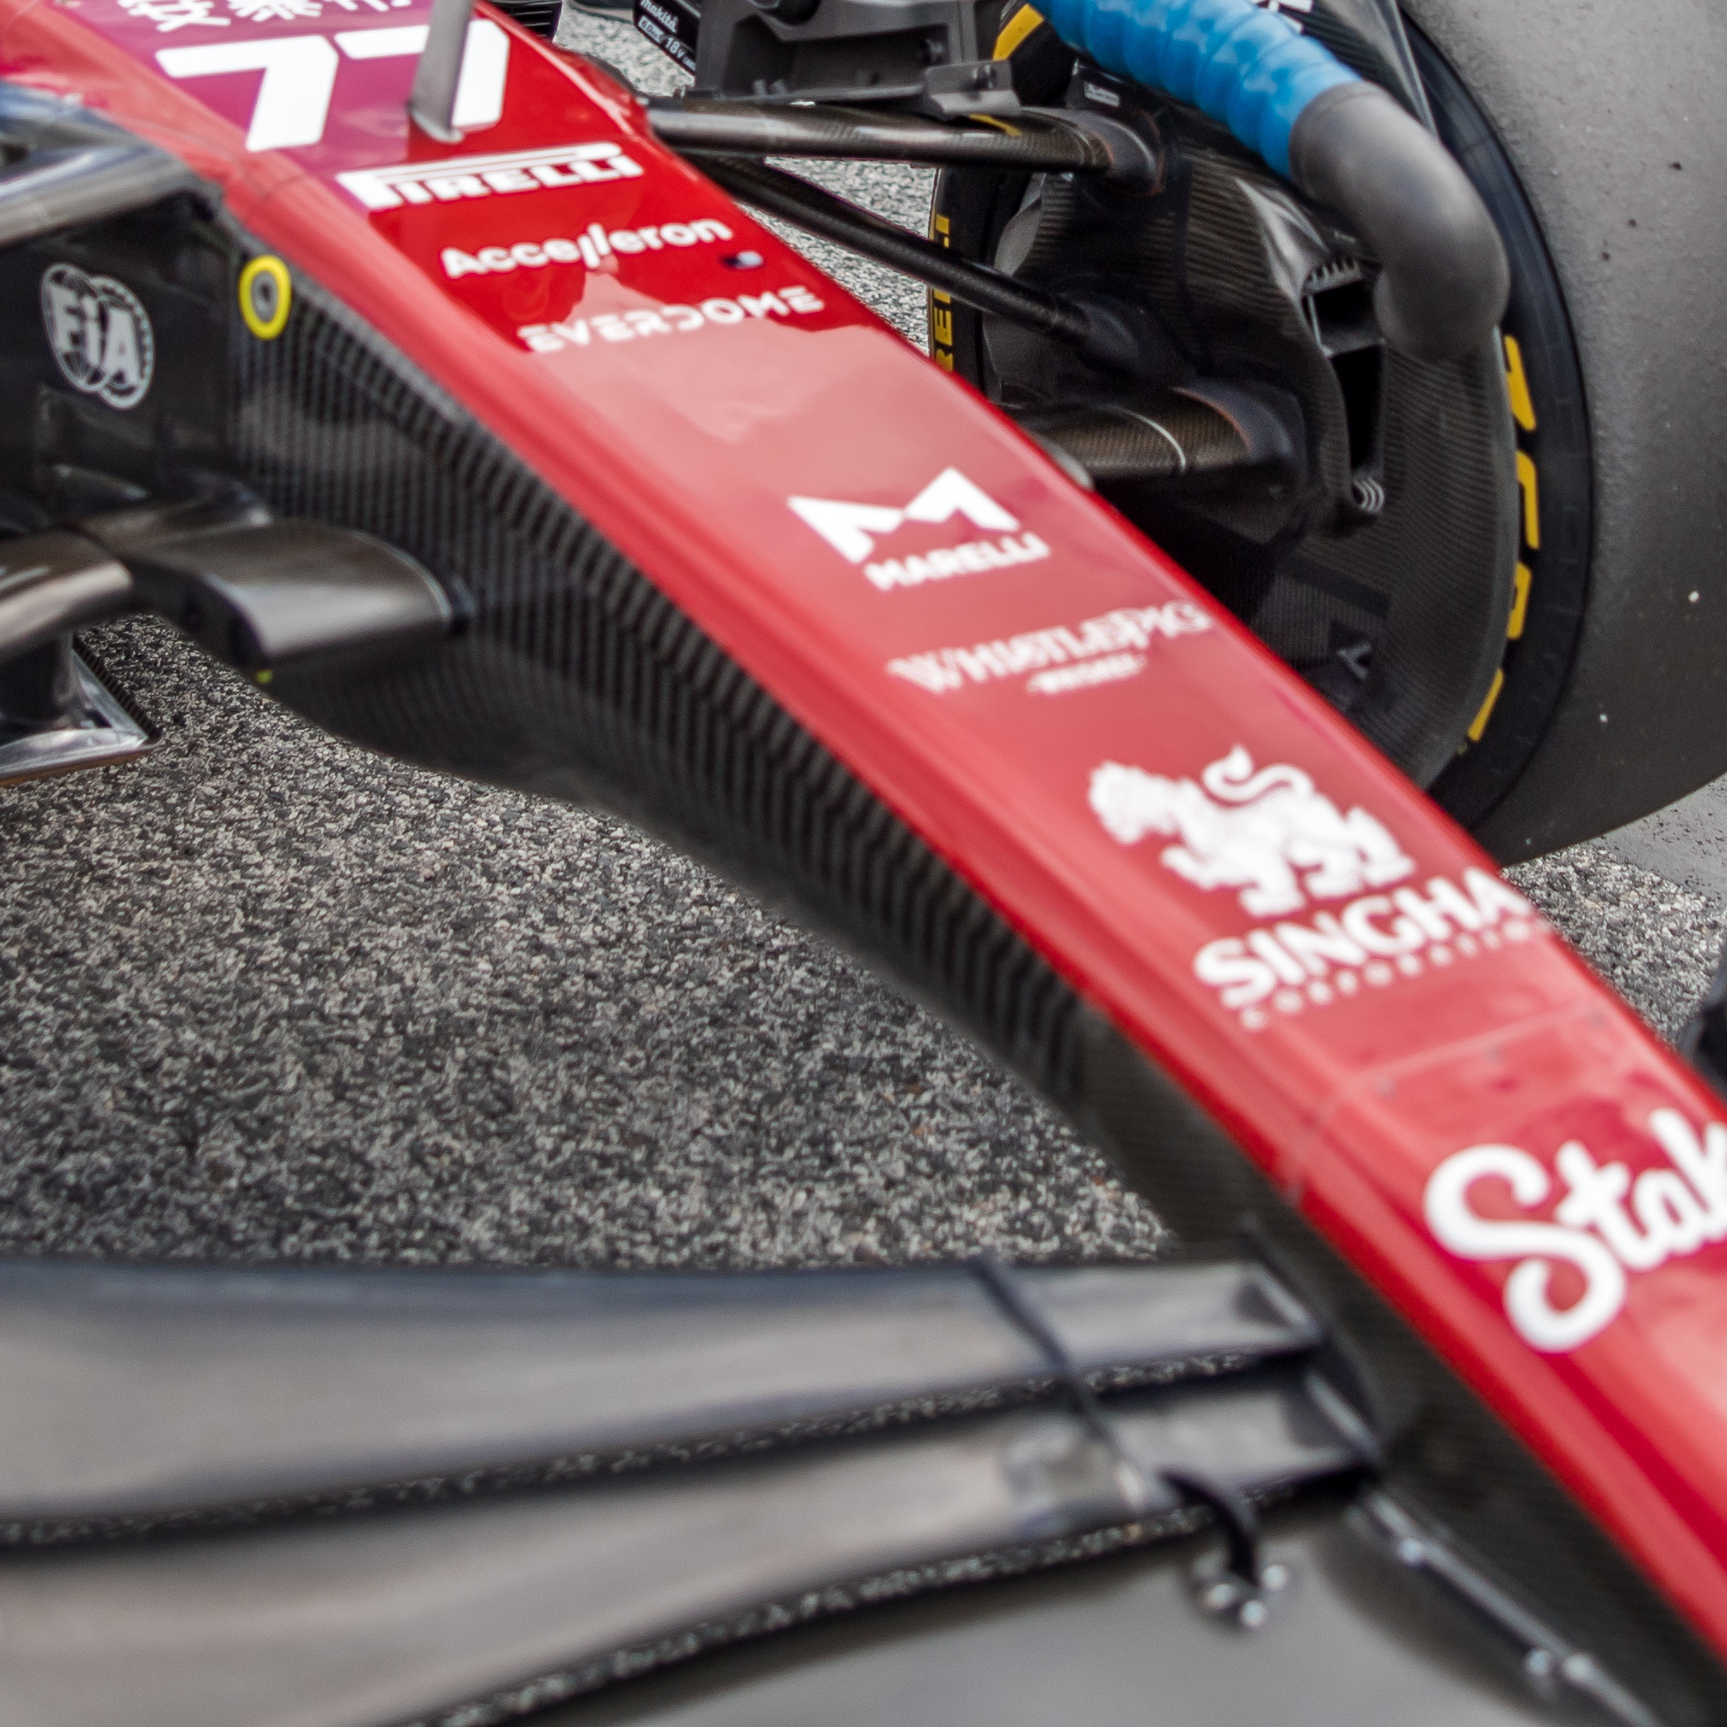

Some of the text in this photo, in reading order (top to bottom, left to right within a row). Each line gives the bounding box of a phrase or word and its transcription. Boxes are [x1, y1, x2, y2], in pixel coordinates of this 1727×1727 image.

[154, 18, 511, 152] 77
[335, 141, 644, 211] PIRELLI
[440, 218, 735, 280] Accelleron
[516, 285, 826, 354] EVERDOME
[863, 531, 1052, 592] MARELLI
[1193, 865, 1535, 1011] SINGHA
